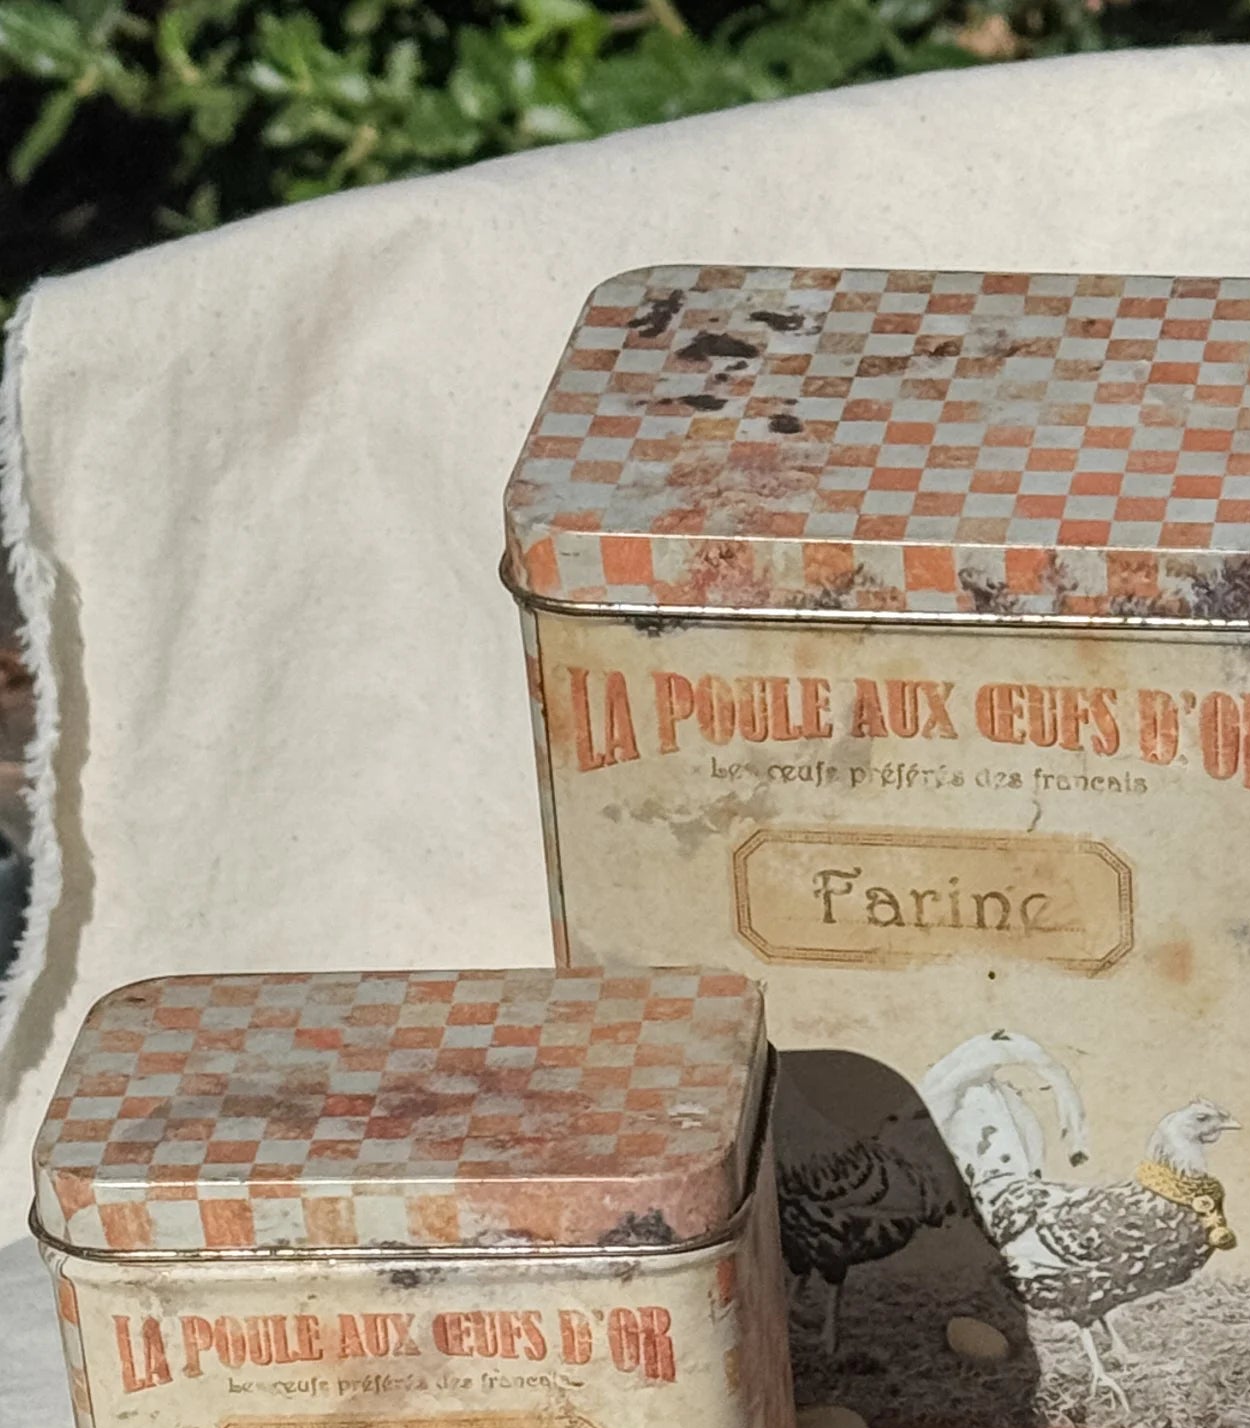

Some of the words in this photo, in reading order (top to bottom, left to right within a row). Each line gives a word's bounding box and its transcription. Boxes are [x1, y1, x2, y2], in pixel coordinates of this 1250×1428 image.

[567, 666, 641, 772] LA
[650, 671, 832, 754] POULE
[850, 678, 957, 742] AUX
[975, 683, 1121, 757] ŒUFS
[112, 1315, 173, 1394] LA
[180, 1313, 324, 1379] POULE
[336, 1312, 421, 1361] AUX
[559, 1305, 678, 1384] D'OR
